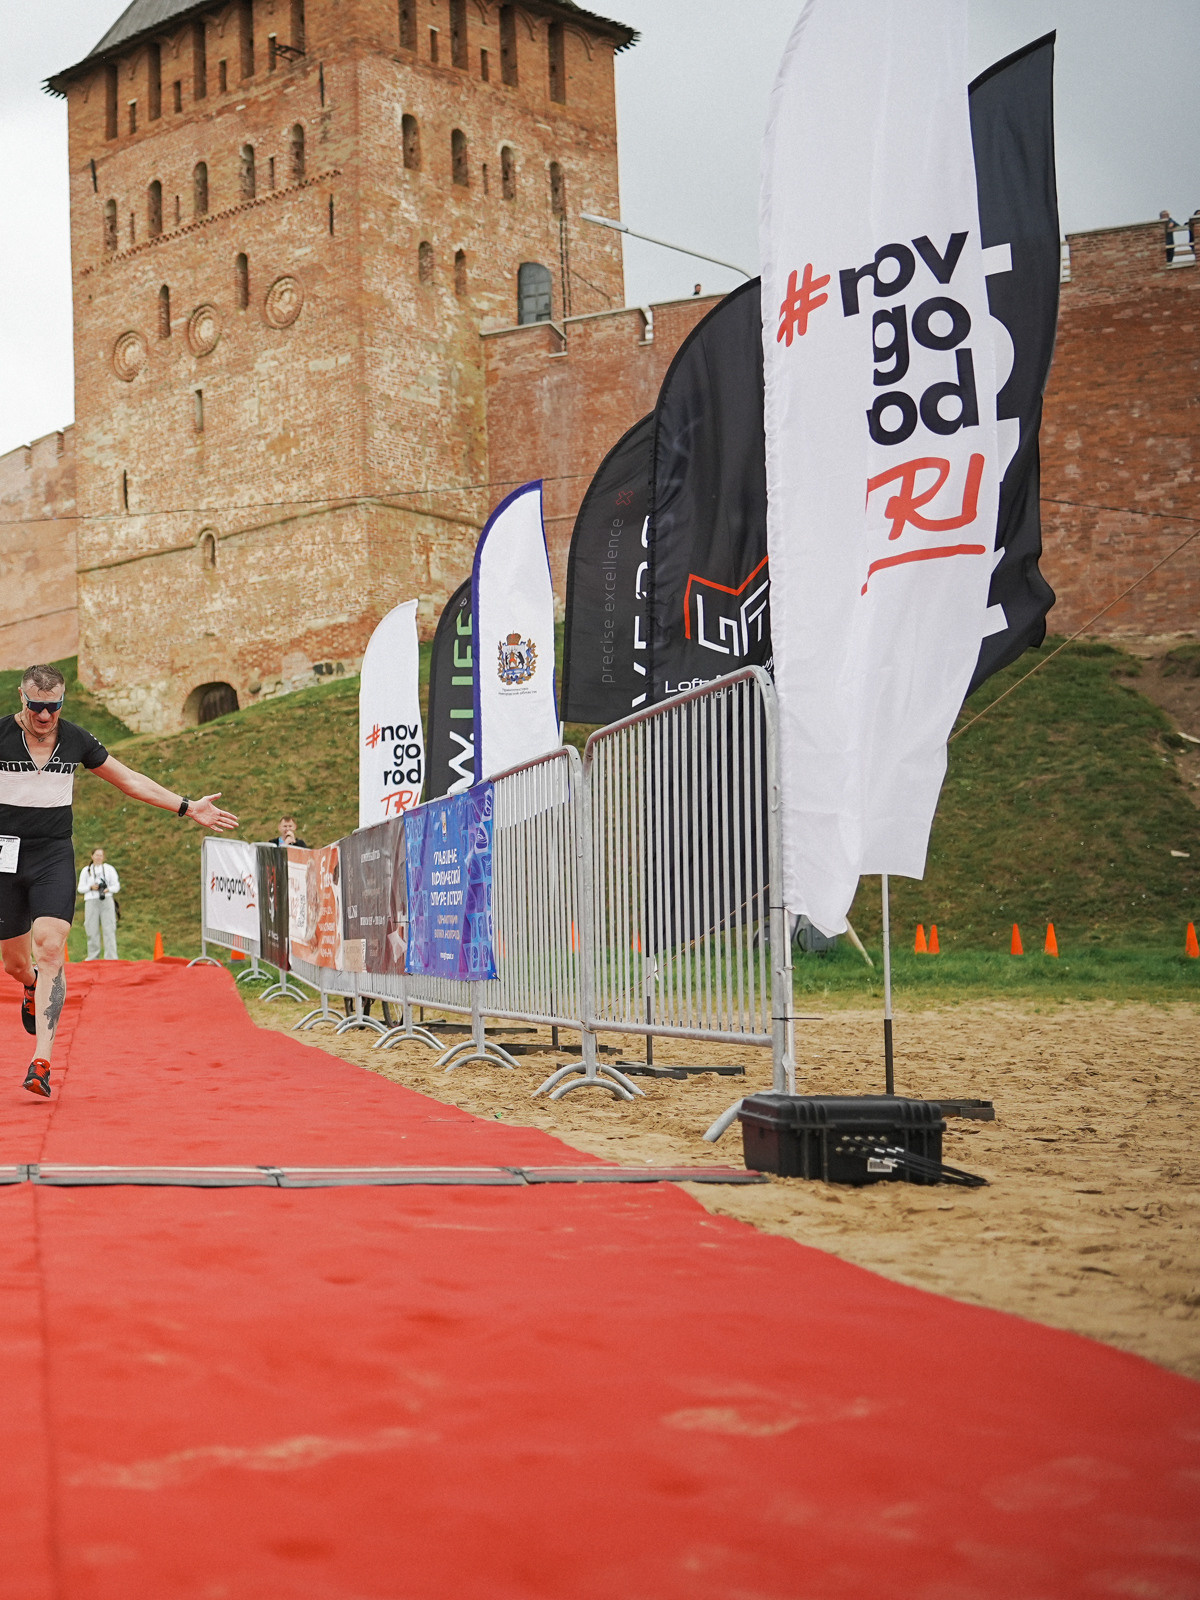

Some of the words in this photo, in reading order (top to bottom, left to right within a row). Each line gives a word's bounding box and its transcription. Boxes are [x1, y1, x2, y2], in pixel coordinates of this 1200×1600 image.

[873, 296, 971, 386] go
[866, 348, 979, 446] od
[603, 518, 624, 612] excellence
[600, 618, 615, 683] precise
[365, 723, 419, 748] #nov
[394, 743, 421, 767] go
[384, 759, 422, 785] rod
[381, 790, 420, 816] TRI
